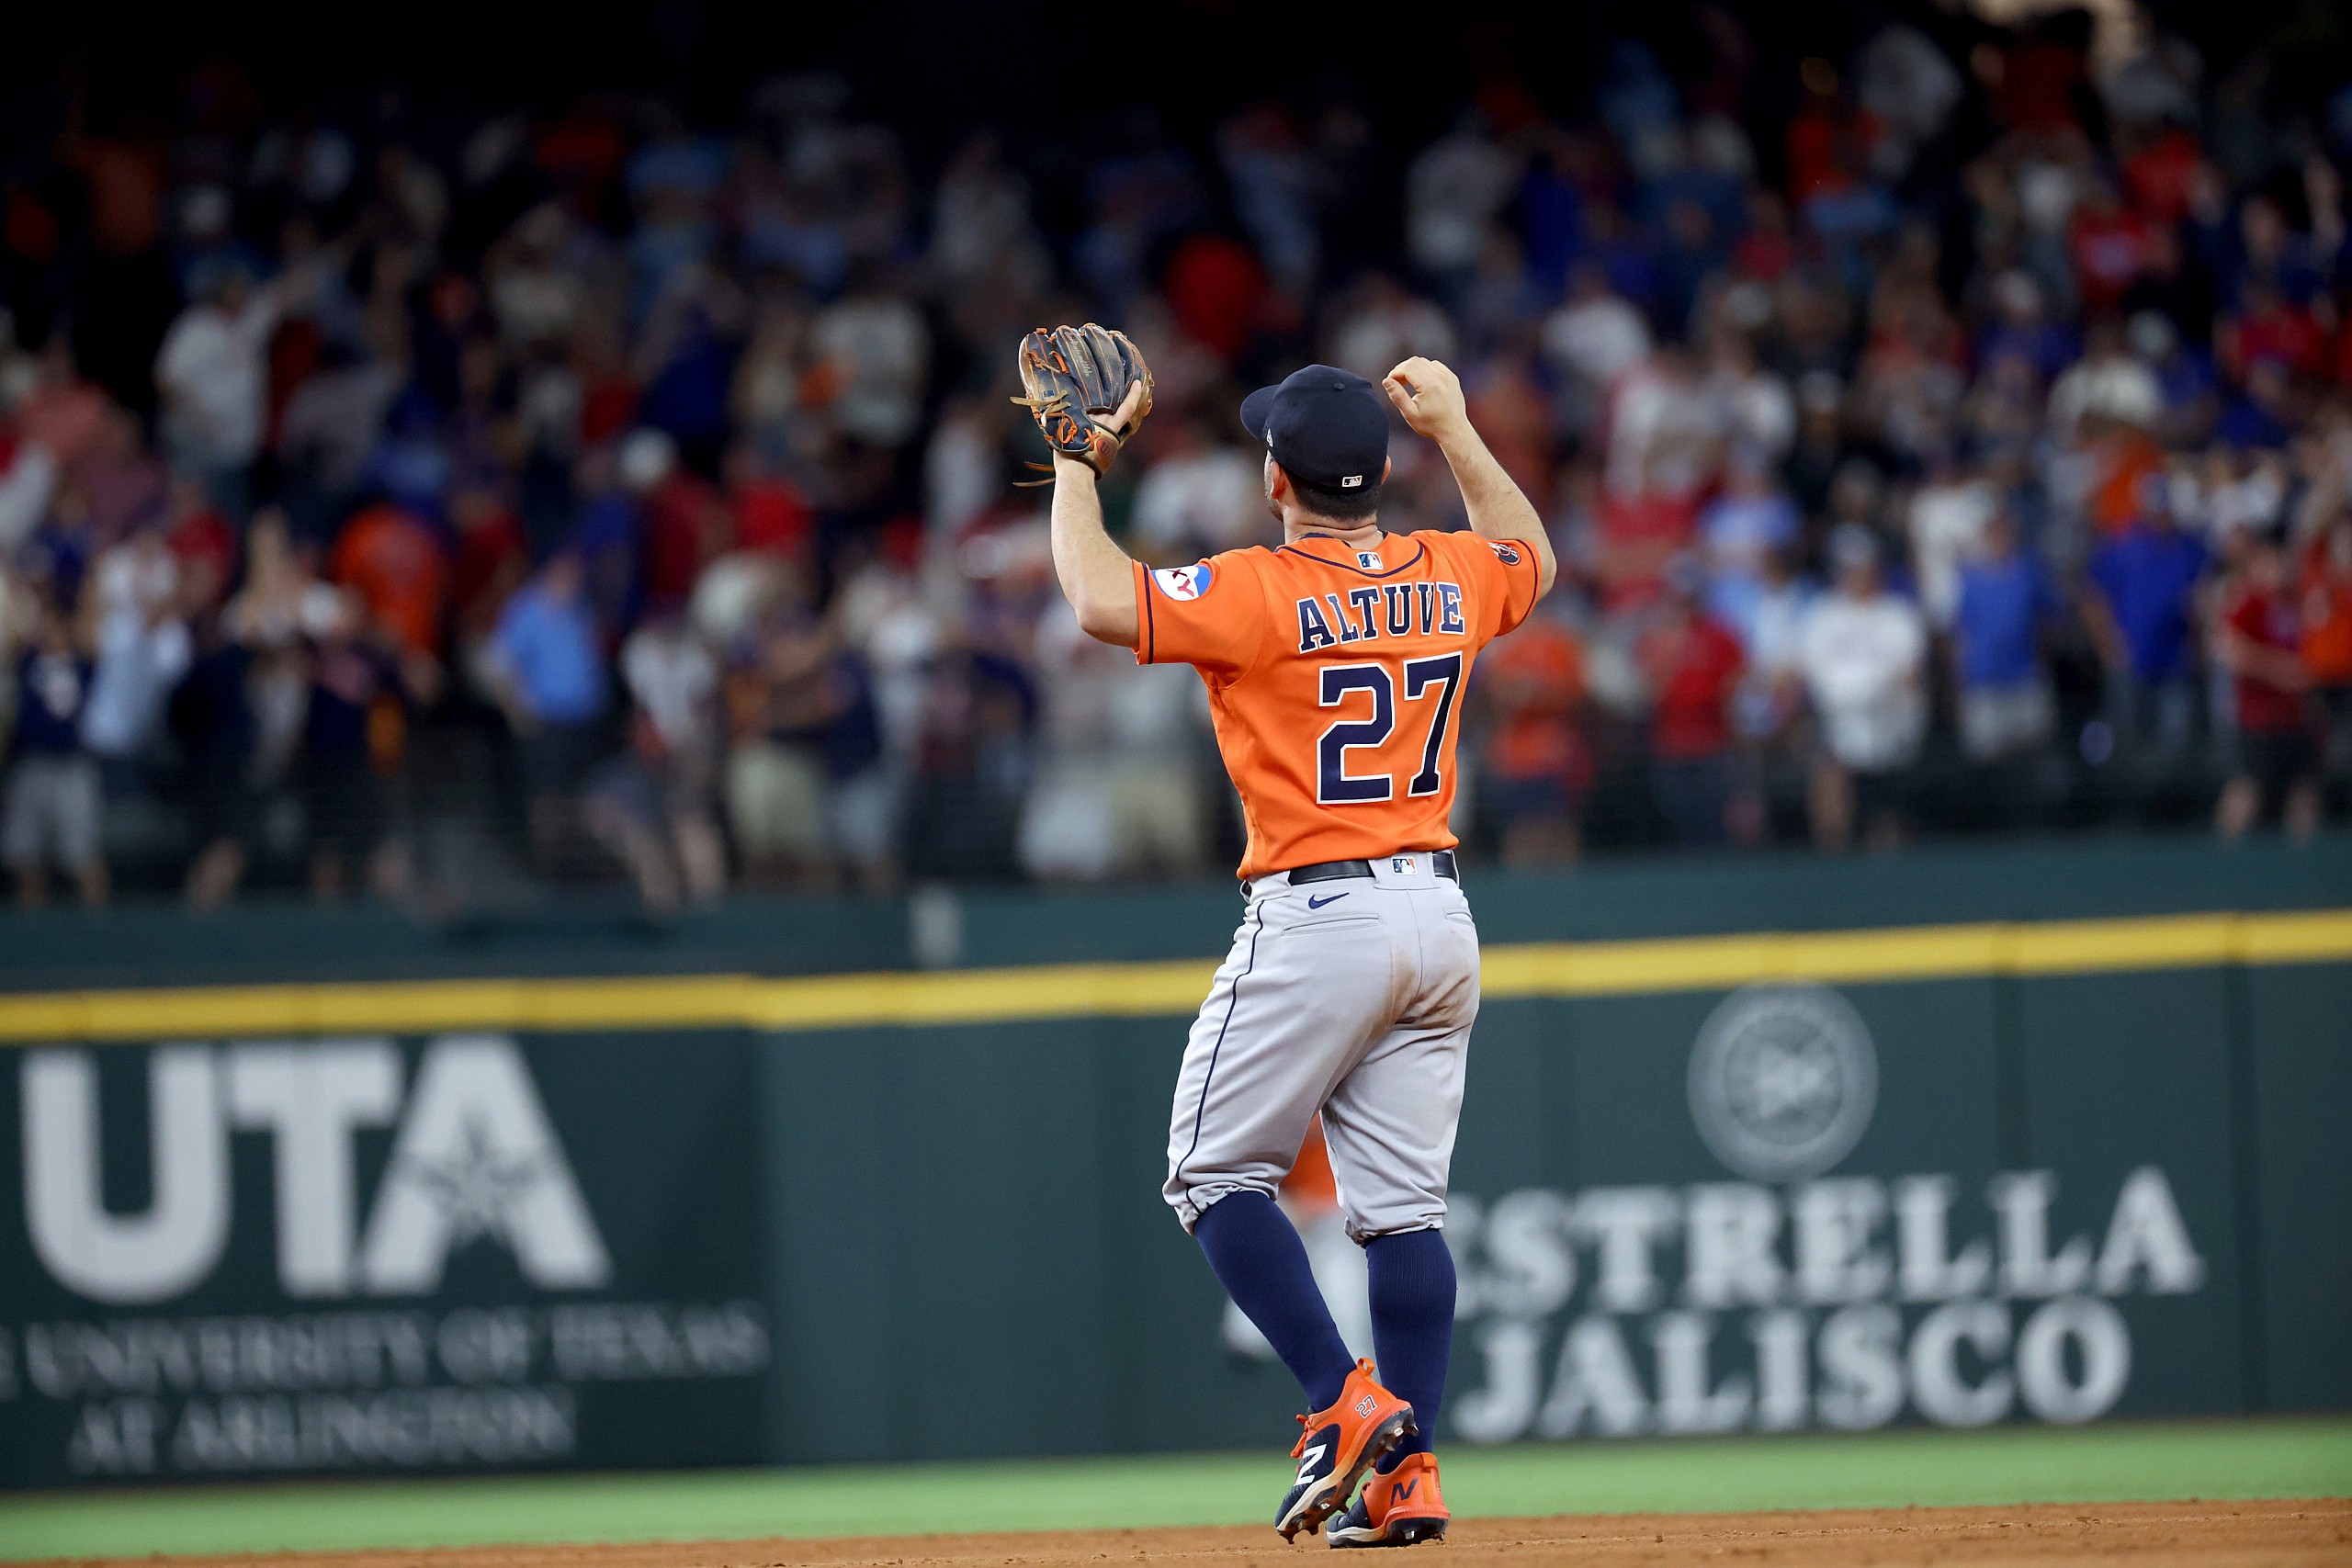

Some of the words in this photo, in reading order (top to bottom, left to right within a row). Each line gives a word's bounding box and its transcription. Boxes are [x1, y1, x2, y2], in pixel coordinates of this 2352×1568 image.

[1295, 581, 1466, 654] ALTUVE
[1316, 650, 1464, 805] 27
[20, 1035, 612, 1303] UTA
[437, 1306, 533, 1383] OF
[1453, 1295, 2132, 1443] JALISCO
[1355, 1394, 1377, 1418] 27
